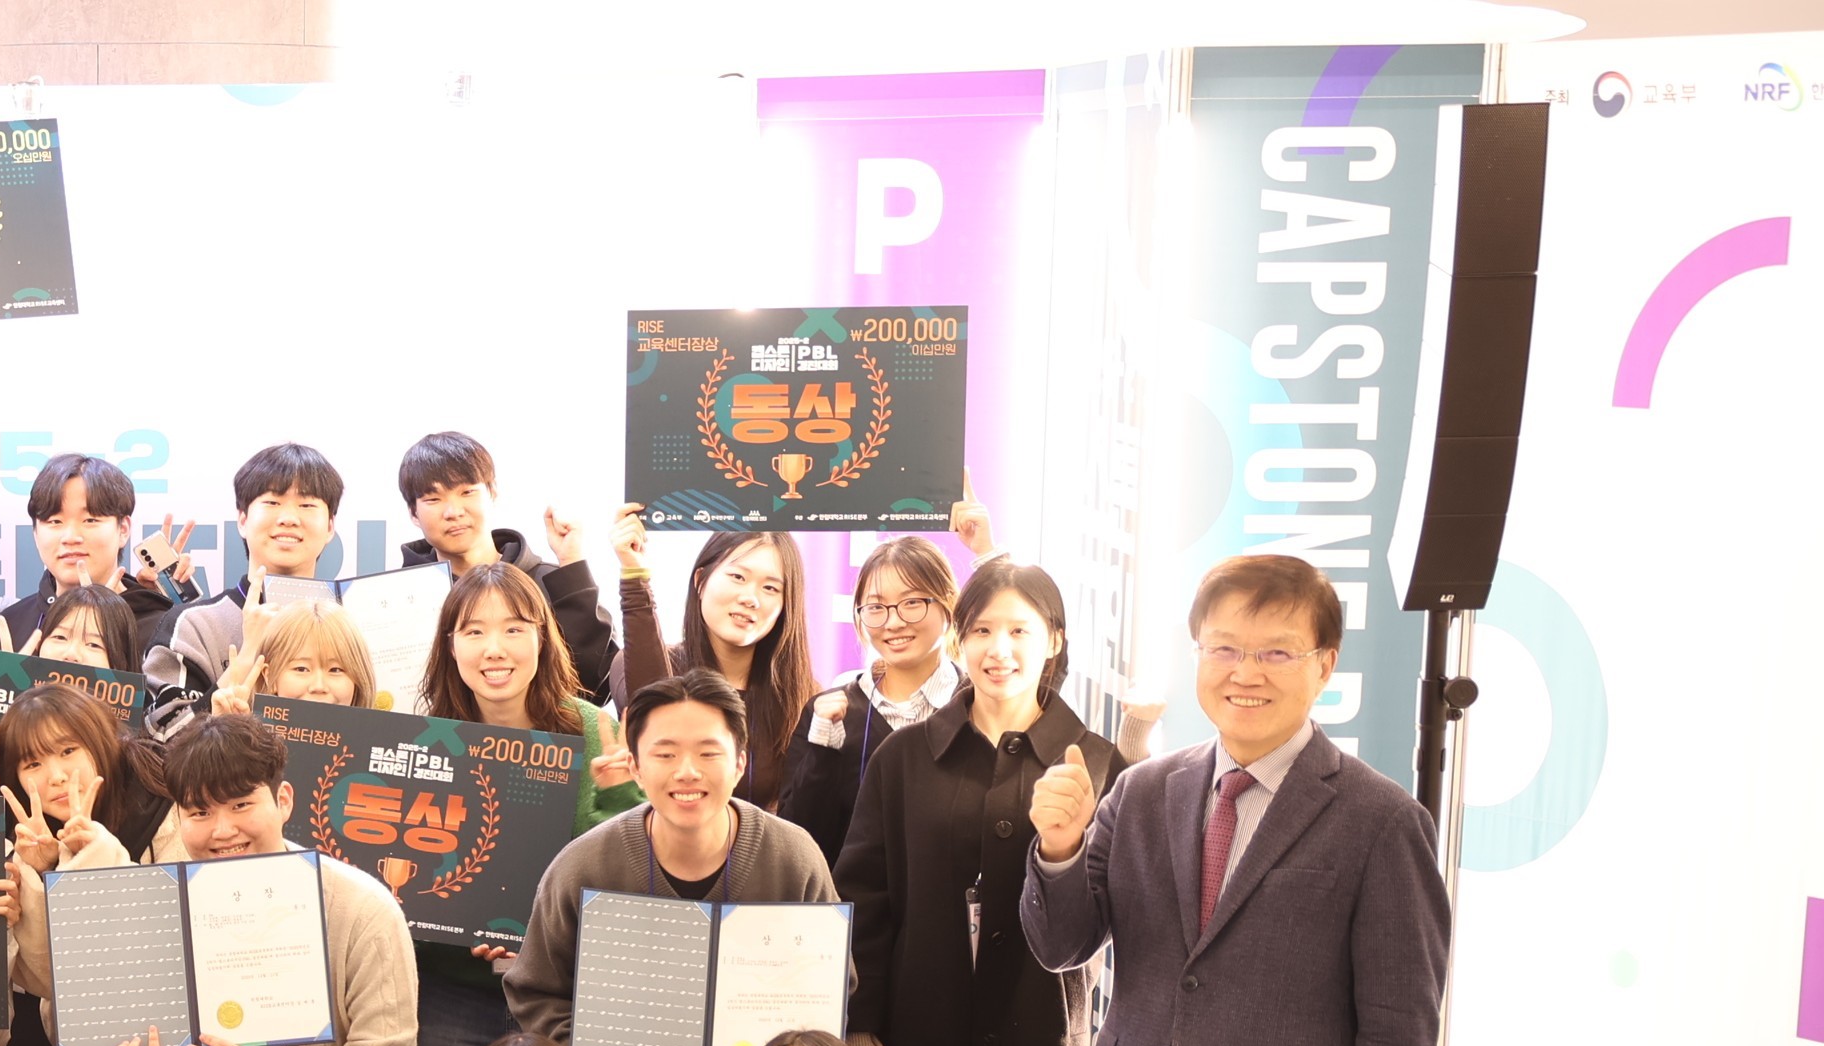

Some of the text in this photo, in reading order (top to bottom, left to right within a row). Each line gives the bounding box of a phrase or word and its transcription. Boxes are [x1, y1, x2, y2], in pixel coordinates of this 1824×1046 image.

[1545, 89, 1569, 105] 주최
[1643, 84, 1696, 104] 교육부
[1745, 83, 1790, 100] NRF
[13, 151, 52, 163] 오십만원
[638, 320, 664, 333] RISE
[851, 317, 957, 344] ₩200,000
[638, 336, 719, 352] 교육센터장상
[912, 344, 956, 356] 이십만원
[798, 346, 838, 359] PBL
[751, 359, 789, 372] 디자인
[731, 382, 856, 444] 동상
[263, 706, 289, 722] RISE
[371, 747, 408, 763] 캡스톤
[398, 742, 428, 753] 2025-2
[469, 737, 572, 770] ₩200,000
[369, 760, 407, 777] 디자인
[416, 754, 454, 771] PBL
[526, 768, 569, 784] 이십만원
[343, 782, 467, 853] 동상
